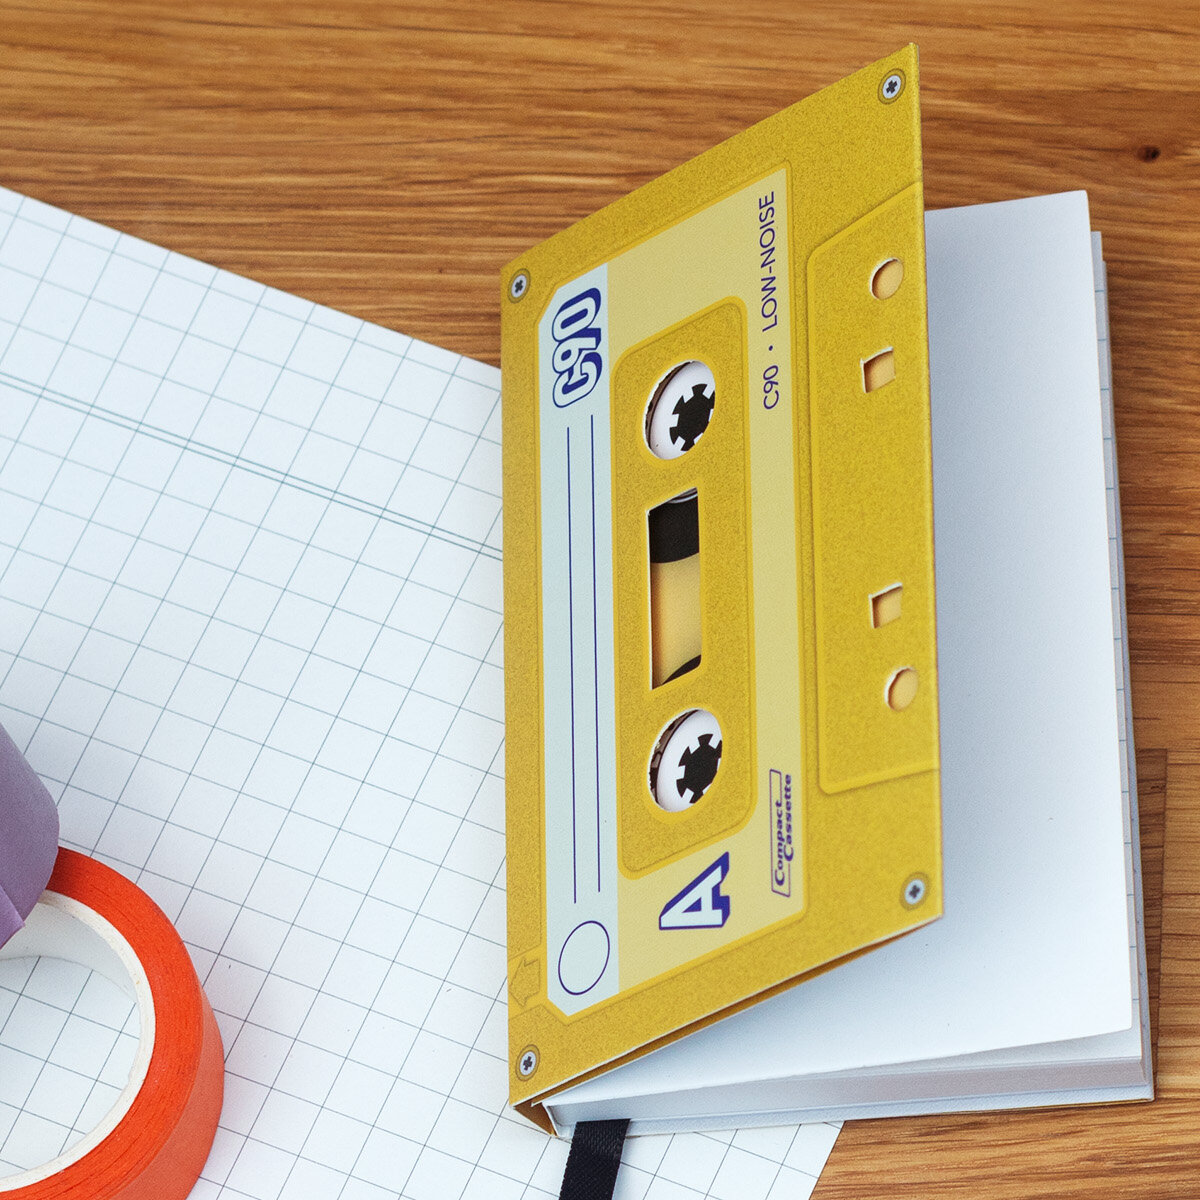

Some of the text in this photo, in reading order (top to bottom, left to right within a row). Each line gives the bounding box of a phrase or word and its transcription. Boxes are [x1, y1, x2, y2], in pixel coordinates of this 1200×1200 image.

[759, 191, 779, 409] C90 LOW-NOISE
[551, 287, 602, 408] C90
[774, 800, 785, 886] Compact
[783, 774, 794, 862] Cassette
[658, 851, 731, 931] A
